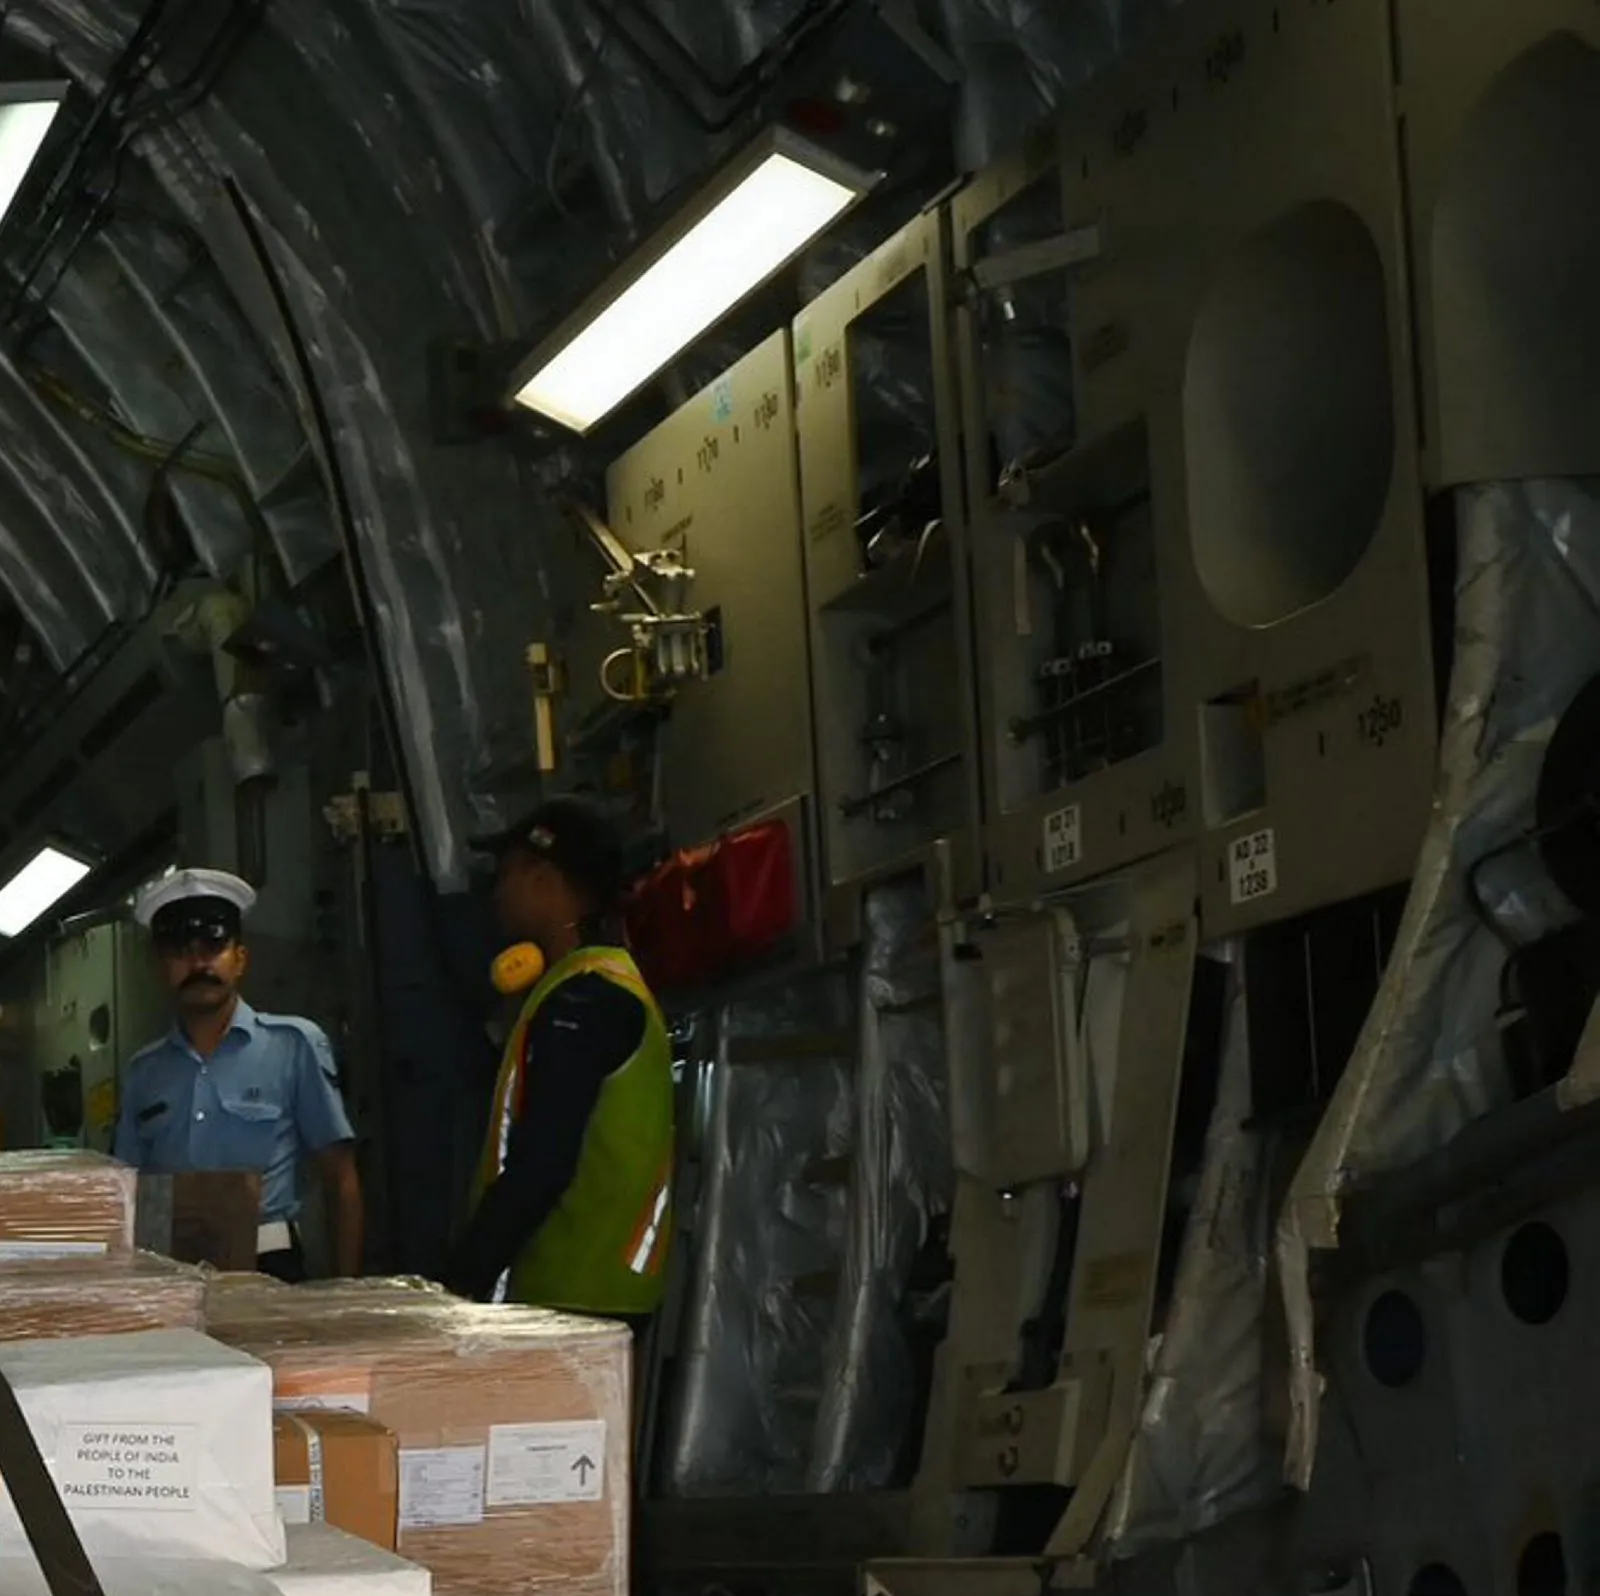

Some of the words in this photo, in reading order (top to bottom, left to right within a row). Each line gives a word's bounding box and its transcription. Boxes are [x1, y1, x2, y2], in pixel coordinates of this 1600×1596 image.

[1357, 698, 1401, 738] 1250
[83, 1433, 110, 1444] GIFT
[112, 1434, 149, 1446] FROM
[152, 1435, 175, 1446] THE
[77, 1449, 121, 1462] PEOPLE
[124, 1450, 140, 1462] OF
[145, 1451, 179, 1463] INDIA
[108, 1467, 125, 1479] TO
[128, 1468, 150, 1480] THE
[63, 1483, 142, 1497] PALESTINIAN
[145, 1486, 189, 1499] PEOPLE
